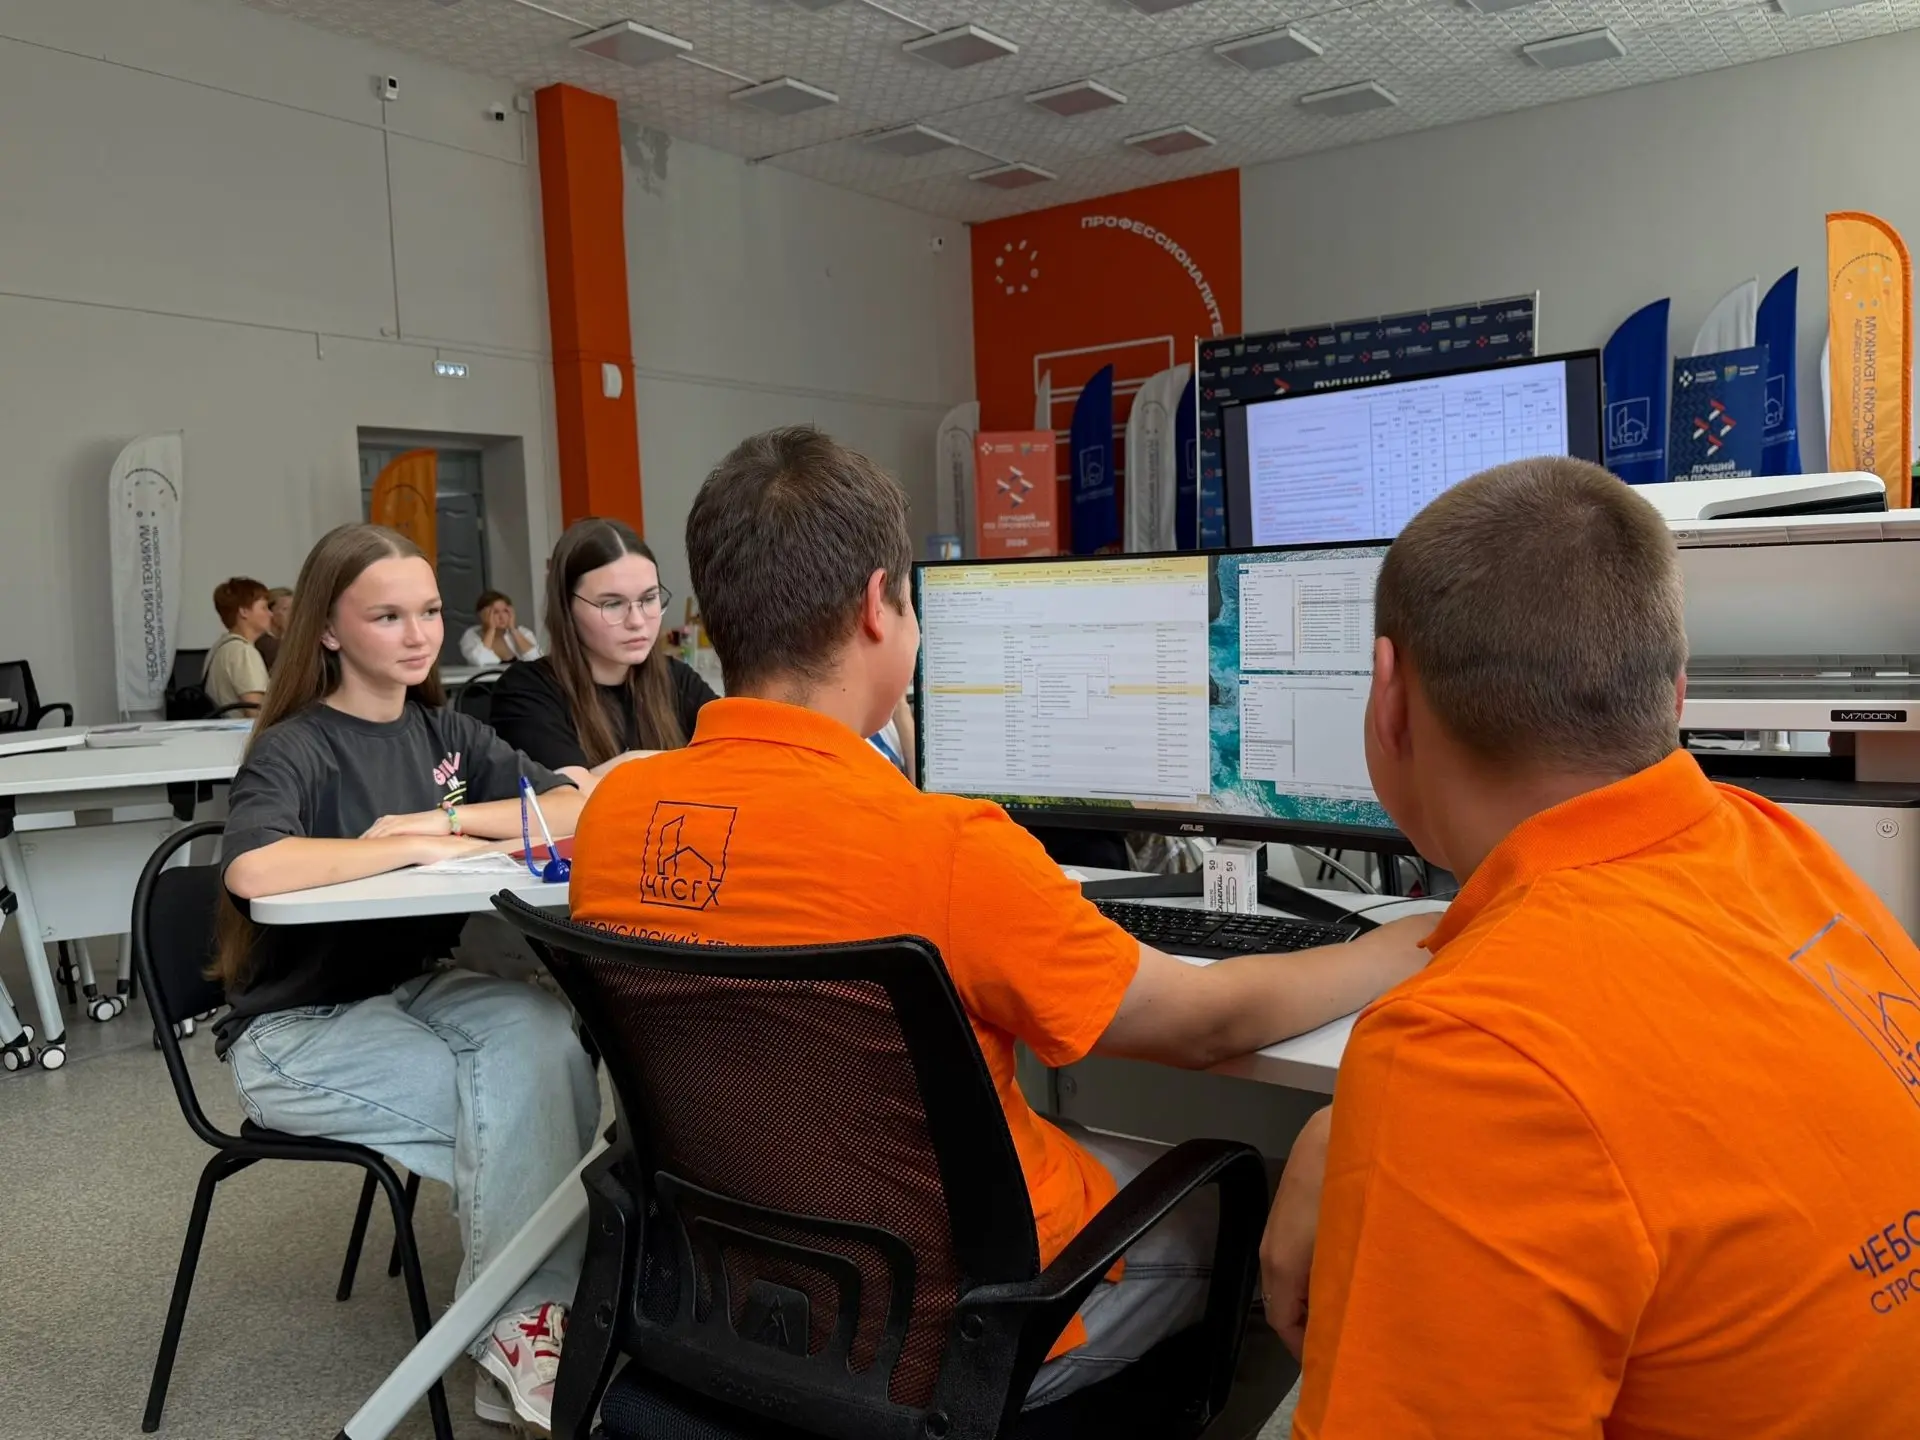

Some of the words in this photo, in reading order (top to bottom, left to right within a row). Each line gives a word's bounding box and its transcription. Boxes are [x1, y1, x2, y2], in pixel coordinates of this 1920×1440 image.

[1081, 215, 1224, 337] ПРОФЕССИОНАЛИТЕ
[1691, 459, 1736, 473] ЛУЧШИЙ
[139, 524, 153, 586] ТЕХНИКУМ
[141, 587, 158, 682] ЧЕБОКСАРСКИЙ
[1179, 822, 1204, 832] ASUS
[645, 875, 721, 906] ЧТСГХ
